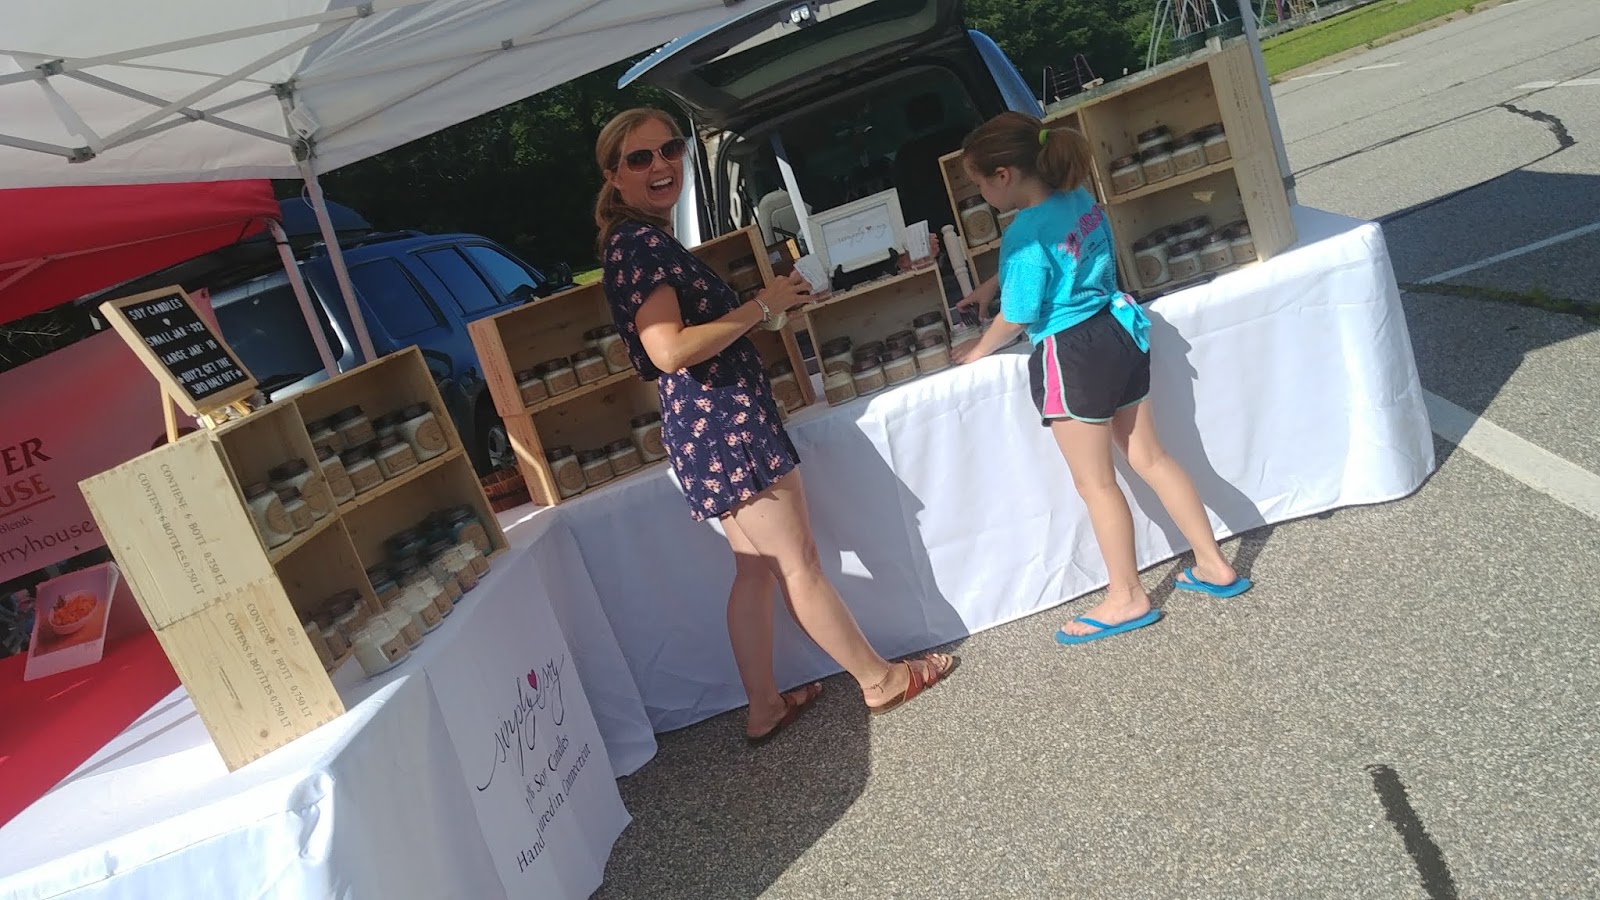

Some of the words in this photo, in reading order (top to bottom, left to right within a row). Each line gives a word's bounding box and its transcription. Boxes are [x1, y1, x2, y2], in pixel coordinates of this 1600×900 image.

[128, 307, 147, 320] SOY
[146, 298, 183, 315] CANDLES
[145, 331, 174, 347] SMALL
[161, 350, 188, 366] LARGE
[181, 368, 199, 383] BUY
[202, 362, 218, 375] GET
[215, 357, 232, 369] THE
[206, 375, 224, 389] HALF
[221, 370, 237, 382] OFF
[0, 437, 53, 476] ER
[137, 472, 163, 515] CONTENS
[192, 583, 205, 596] LT
[160, 463, 189, 510] CONTIENE
[215, 574, 227, 586] LT
[225, 612, 251, 652] CONTENS
[250, 658, 275, 696] BOTTLES
[280, 716, 292, 728] LT
[246, 602, 276, 646] CONTIENE
[301, 706, 313, 718] LT
